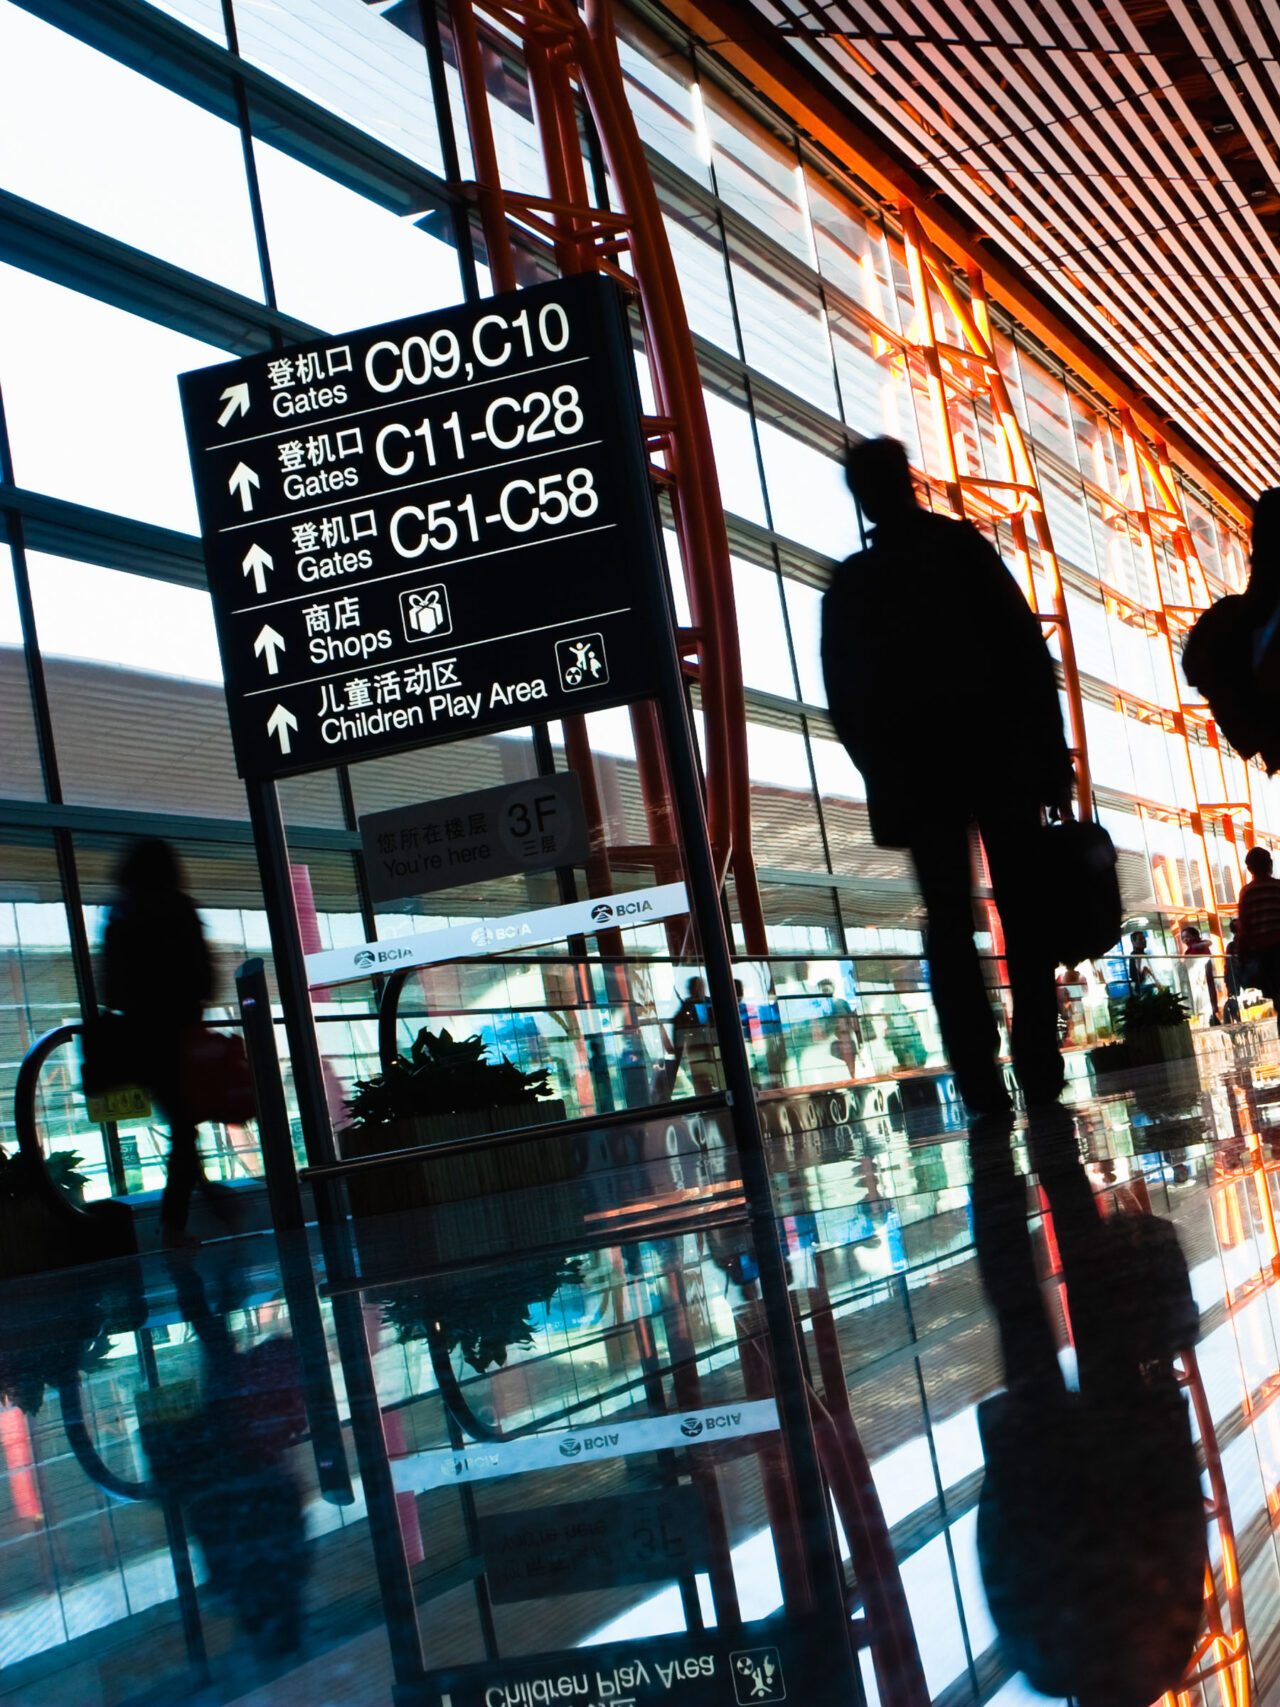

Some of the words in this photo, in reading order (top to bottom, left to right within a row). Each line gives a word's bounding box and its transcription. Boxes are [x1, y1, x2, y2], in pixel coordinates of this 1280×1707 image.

[267, 345, 353, 390] 登机口
[365, 302, 570, 393] C09,C10
[273, 382, 348, 418] Gates
[278, 427, 364, 473] 登机口
[376, 384, 584, 475] C11-C28
[283, 464, 358, 500] Gates
[292, 509, 377, 555] 登机口
[390, 467, 598, 558] C51-C58
[298, 544, 373, 582] Gates
[303, 596, 360, 637] 商店
[310, 625, 391, 664] Shops
[317, 658, 462, 717] 儿童活动区
[321, 701, 423, 745] Children
[430, 689, 480, 722] Play
[490, 675, 547, 708] Area
[376, 813, 488, 854] 您所在楼层
[508, 795, 556, 837] 3F
[384, 853, 442, 877] You're
[449, 843, 491, 865] here
[523, 836, 556, 857] 三层
[616, 900, 653, 916] BCIA
[495, 923, 532, 941] BCIA
[378, 947, 413, 963] BCIA
